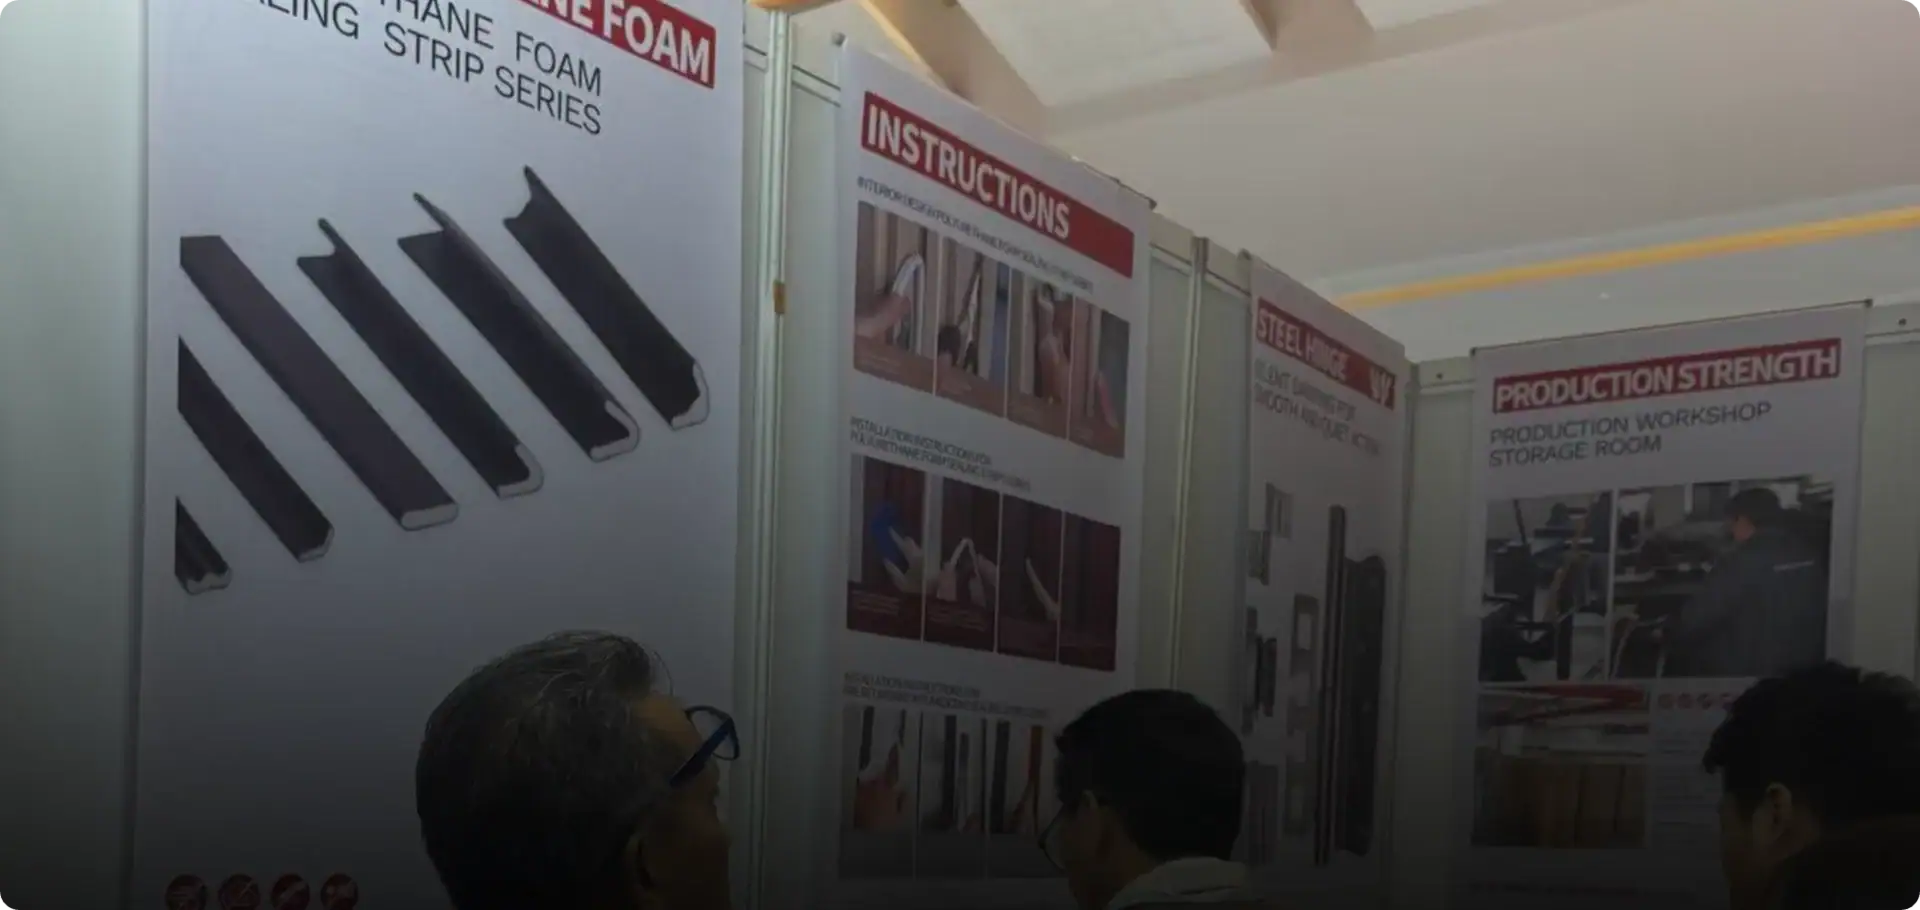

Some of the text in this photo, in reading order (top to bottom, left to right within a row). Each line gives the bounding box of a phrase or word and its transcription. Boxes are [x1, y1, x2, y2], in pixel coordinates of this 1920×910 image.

[259, 0, 601, 135] ING STRIP SERIES
[380, 0, 494, 50] HANE
[516, 31, 601, 96] FOAM
[603, 0, 710, 83] FOAM
[867, 104, 1070, 239] INSTRUCTIONS
[1258, 308, 1302, 358] STEEL
[1496, 346, 1838, 409] PRODUCTION STRENGTH
[1489, 435, 1662, 468] STORAGE ROOM
[1490, 401, 1773, 445] PRODUCTION WORKSHOP
